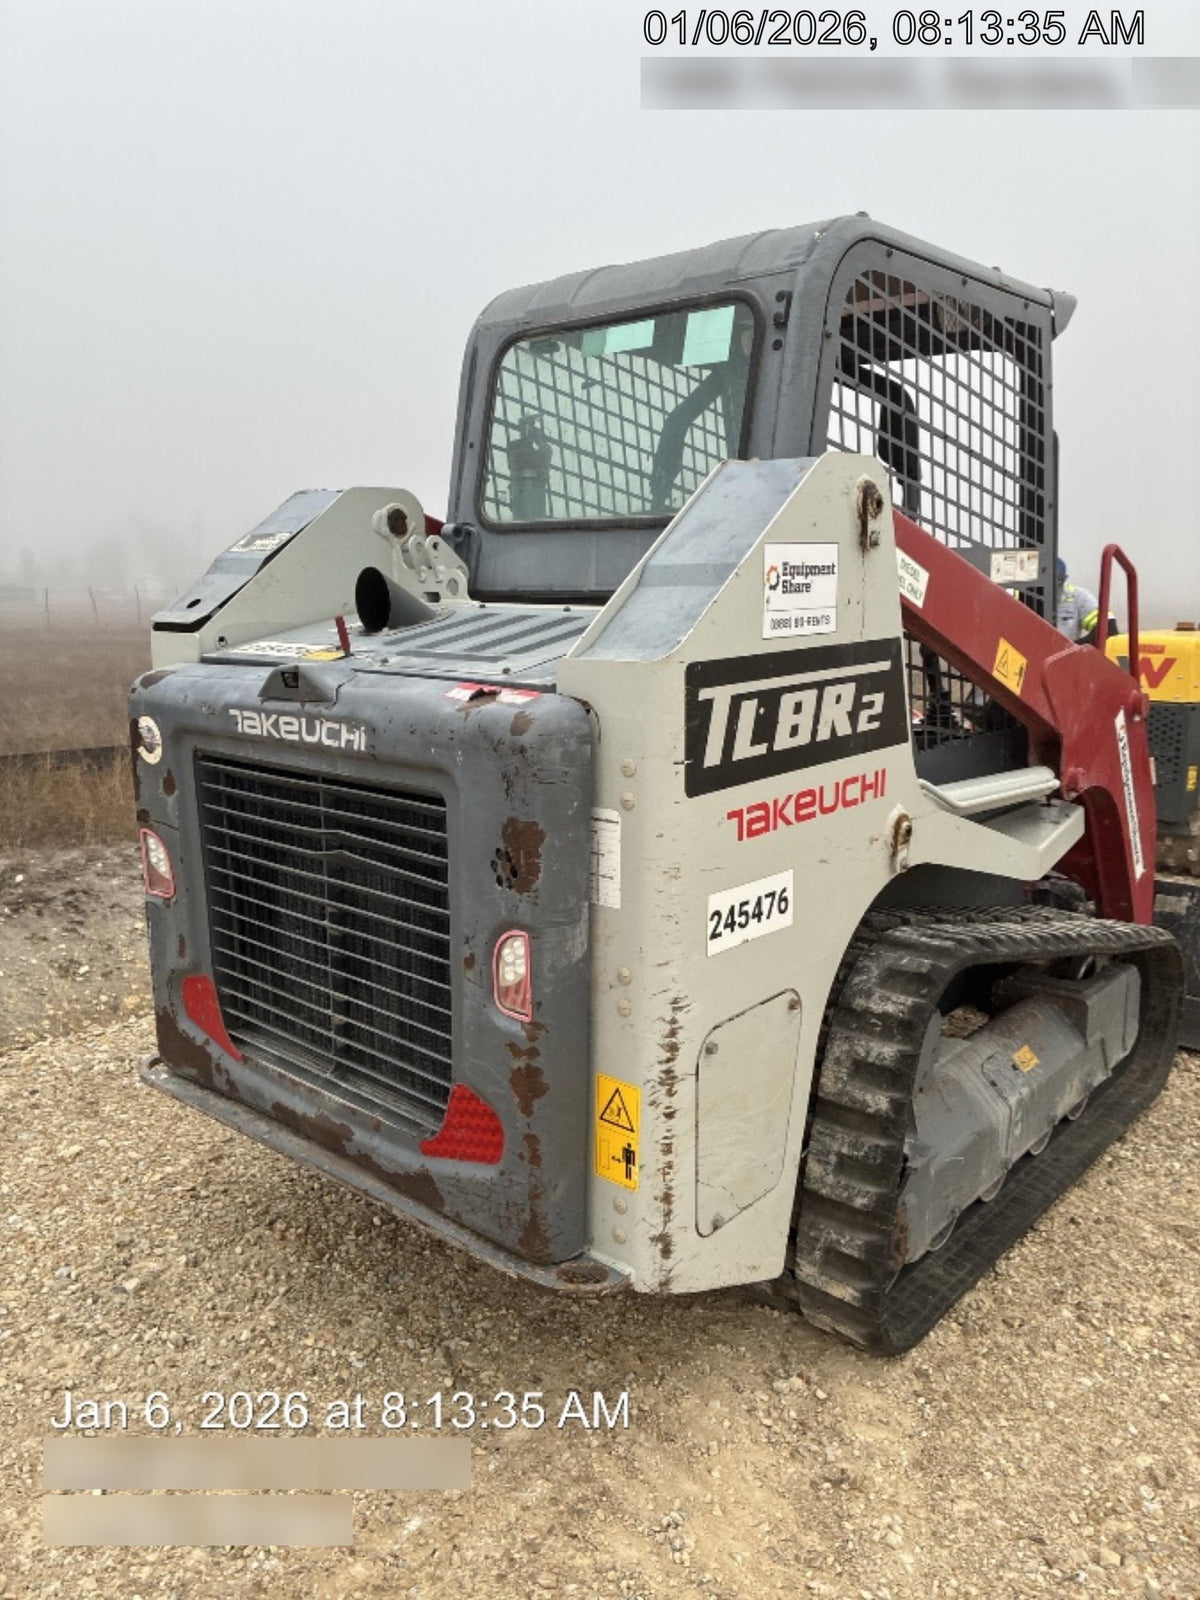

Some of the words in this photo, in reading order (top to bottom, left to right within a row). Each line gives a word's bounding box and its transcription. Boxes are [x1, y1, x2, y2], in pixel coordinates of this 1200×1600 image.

[781, 580, 812, 595] Share
[782, 561, 837, 580] Equipment
[698, 660, 892, 769] TL8R2
[708, 886, 790, 942] 245476
